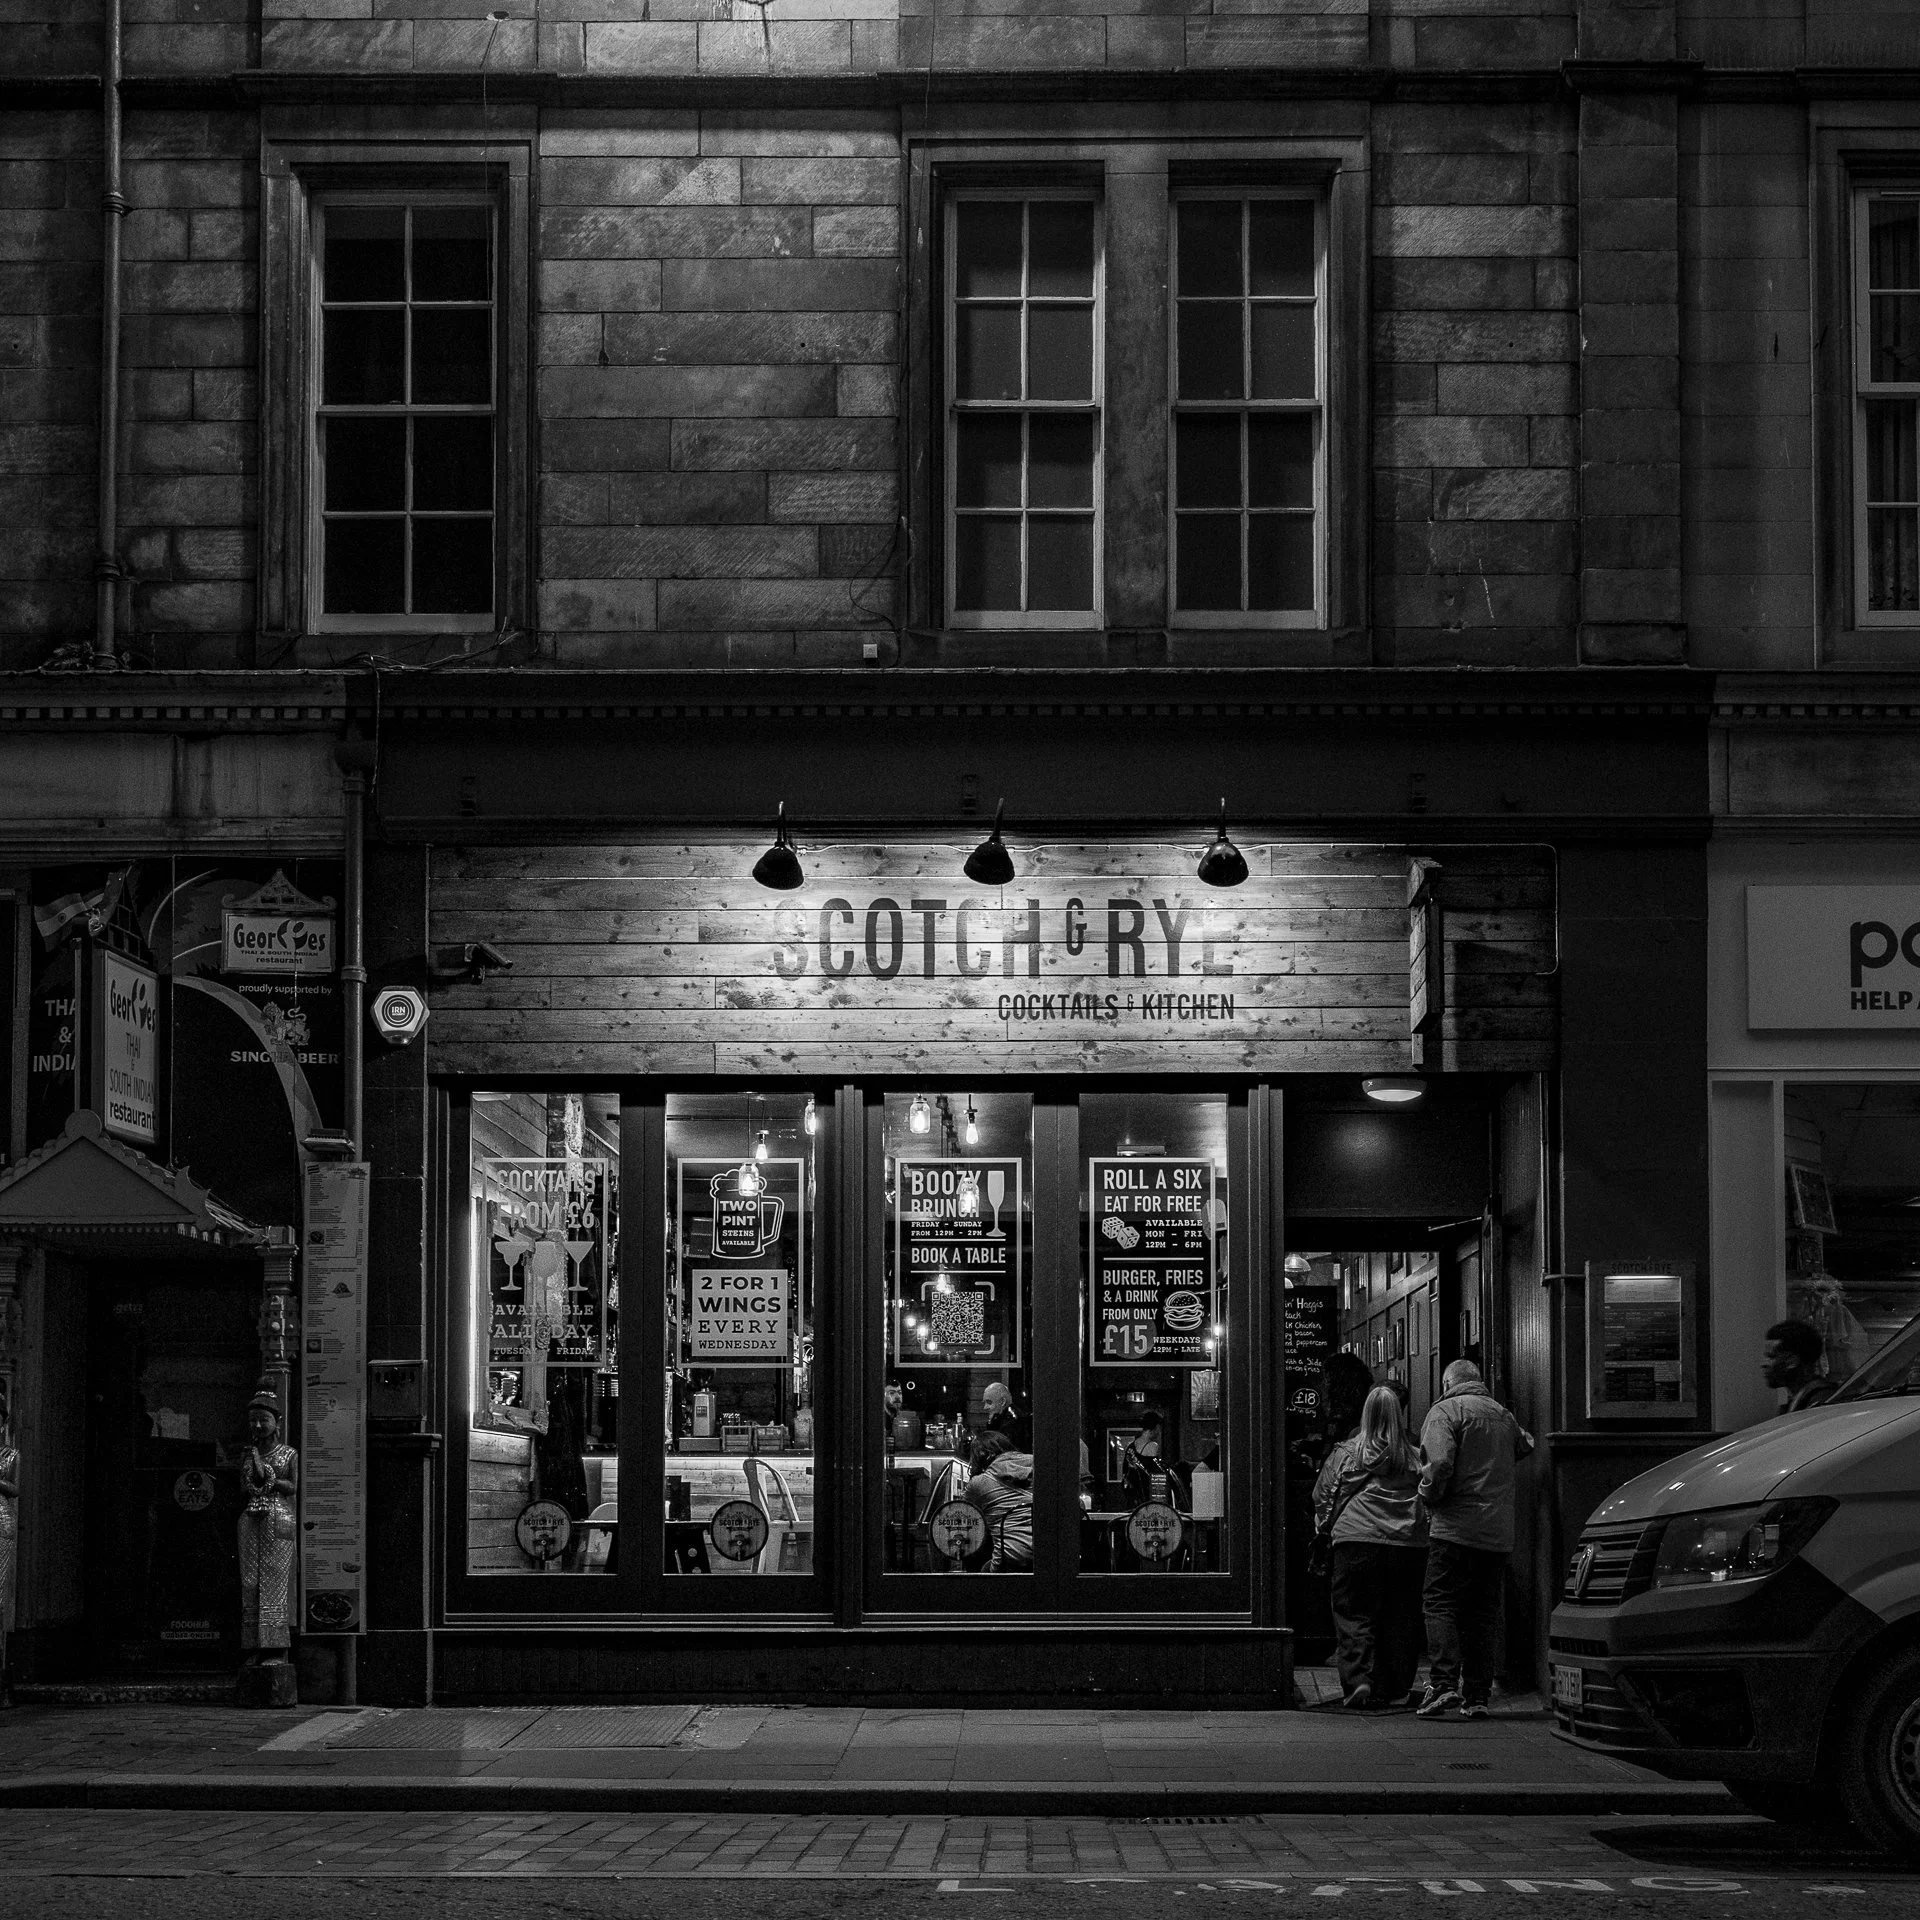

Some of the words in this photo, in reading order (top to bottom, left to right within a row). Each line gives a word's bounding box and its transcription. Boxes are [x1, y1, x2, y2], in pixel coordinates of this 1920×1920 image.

[773, 897, 1041, 981] SCOTCH
[1107, 898, 1234, 979] RYE
[238, 984, 272, 995] proudly
[274, 984, 319, 995] supported
[321, 985, 332, 996] by
[998, 994, 1119, 1021] COCKTAILS
[1142, 994, 1235, 1021] KITCHEN
[1851, 991, 1913, 1010] HELP
[59, 1026, 72, 1044] &
[126, 1032, 141, 1059] THAI
[298, 1052, 339, 1064] BEER
[110, 1068, 132, 1097] SOUTH
[110, 1101, 156, 1131] restaurant
[498, 1169, 596, 1194] COCKTAILS
[911, 1170, 982, 1195] BOOZY
[1103, 1169, 1149, 1190] ROLL
[1155, 1169, 1167, 1190] A
[1173, 1169, 1203, 1190] SIX
[720, 1200, 757, 1211] TWO
[911, 1199, 980, 1218] BRUNCH
[1104, 1195, 1127, 1212] EAT
[1134, 1195, 1162, 1212] FOR
[1166, 1195, 1202, 1212] FREE
[497, 1202, 560, 1229] FROM
[568, 1199, 595, 1229] £6
[722, 1215, 756, 1226] PINT
[1145, 1219, 1203, 1227] AVAILABLE
[722, 1229, 754, 1237] STEINS
[1145, 1230, 1164, 1238] MON
[1184, 1230, 1203, 1238] FRI
[911, 1247, 948, 1264] BOOK
[952, 1247, 962, 1264] A
[966, 1247, 1006, 1264] TABLE
[1611, 1262, 1647, 1275] SCOTCH
[701, 1276, 713, 1290] 2
[721, 1276, 764, 1290] FOR
[771, 1276, 779, 1290] 1
[1103, 1269, 1161, 1287] BURGER,
[1165, 1269, 1204, 1286] FRIES
[1103, 1290, 1112, 1303] &
[1114, 1290, 1123, 1303] A
[1126, 1290, 1159, 1303] DRINK
[494, 1304, 594, 1316] AVAIBLE
[698, 1297, 781, 1313] WINGS
[1102, 1308, 1130, 1320] FROM
[1134, 1308, 1158, 1320] ONLY
[493, 1324, 533, 1339] ALL
[551, 1324, 594, 1339] DAY
[698, 1320, 778, 1334] EVERY
[699, 1340, 777, 1349] WEDNESDAY
[1103, 1324, 1148, 1355] £15
[1153, 1336, 1201, 1344] WEEKDAYS
[494, 1347, 537, 1355] TUESDAY
[556, 1347, 594, 1355] FRIDAY
[1294, 1391, 1316, 1405] £18
[938, 1877, 1742, 1895] LING
